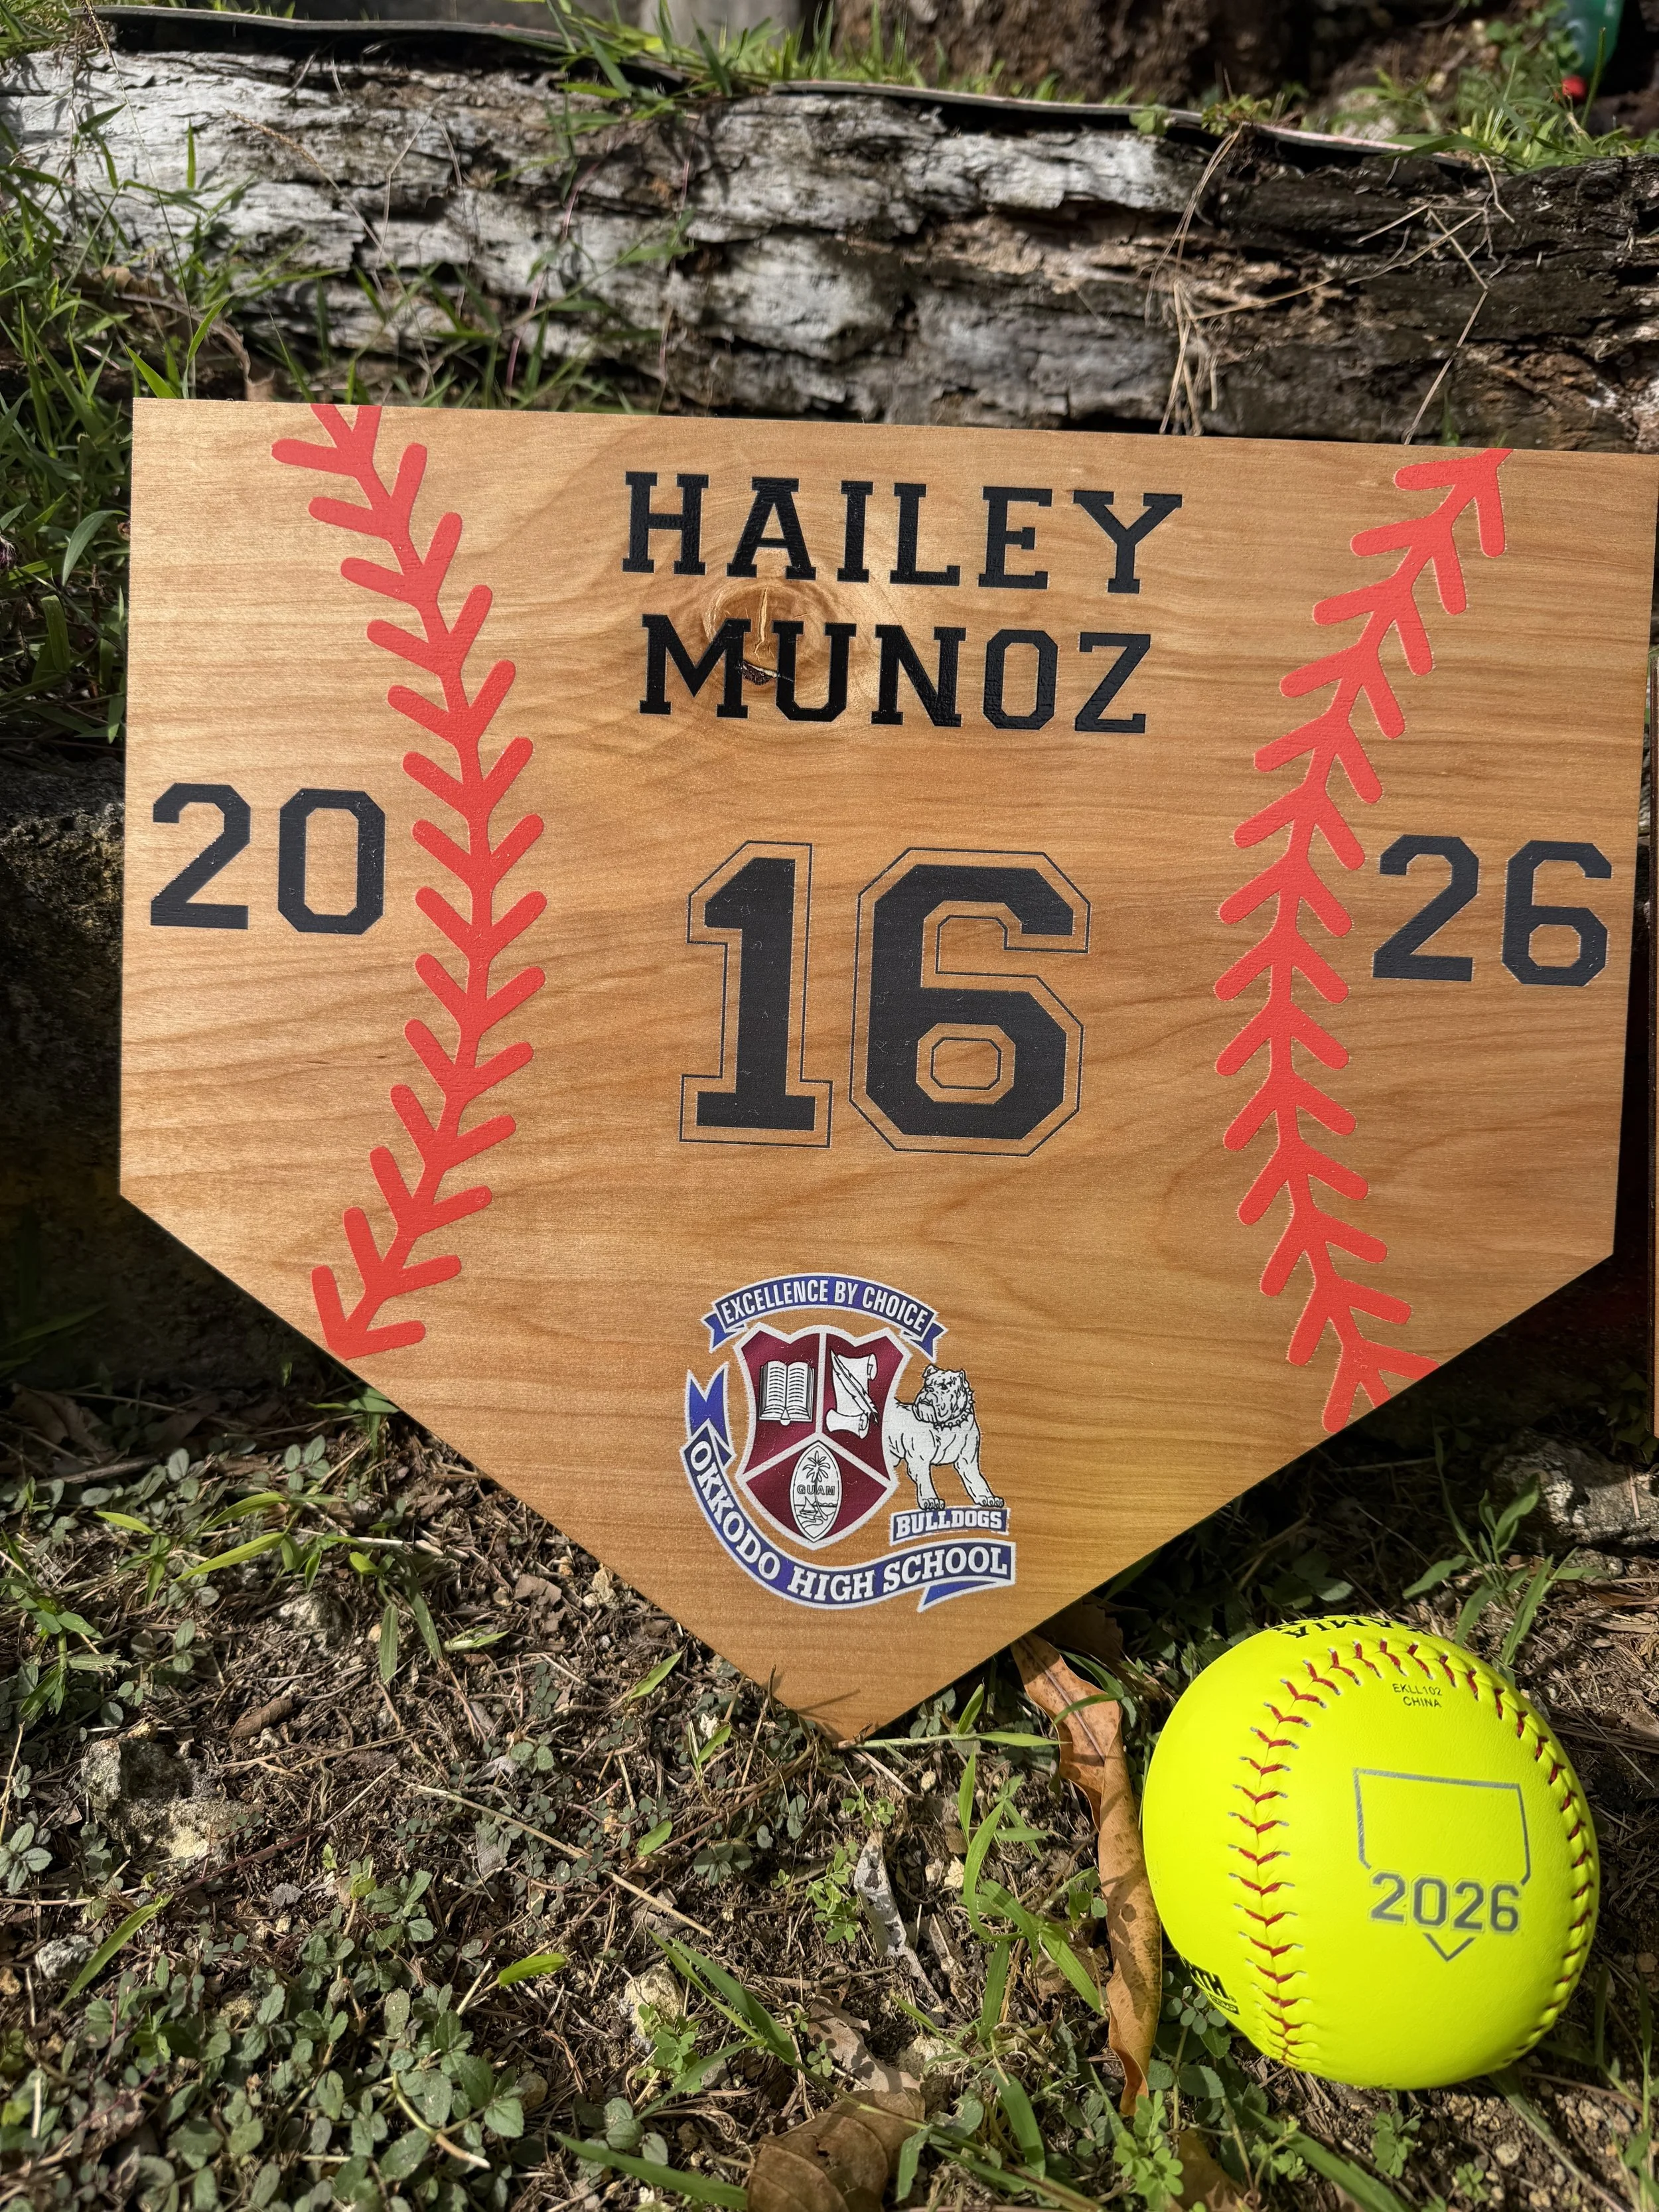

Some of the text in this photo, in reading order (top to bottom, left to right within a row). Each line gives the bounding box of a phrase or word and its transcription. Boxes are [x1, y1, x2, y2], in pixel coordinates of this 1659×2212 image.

[622, 471, 1183, 594] HAILEY
[639, 614, 1151, 734] MUNOZ
[150, 782, 386, 935] 20
[1372, 834, 1613, 988] 26
[680, 840, 1092, 1157] 16
[721, 1280, 929, 1333] EXCELLENCE BY CHOICE
[689, 1439, 1008, 1601] OKKODO HIGH SCHOOL
[796, 1484, 835, 1496] GUAM
[895, 1510, 1003, 1540] BULLDOGS
[1392, 1682, 1443, 1696] EKLL102
[1402, 1696, 1442, 1708] CHINA
[1368, 1869, 1520, 1933] 2026
